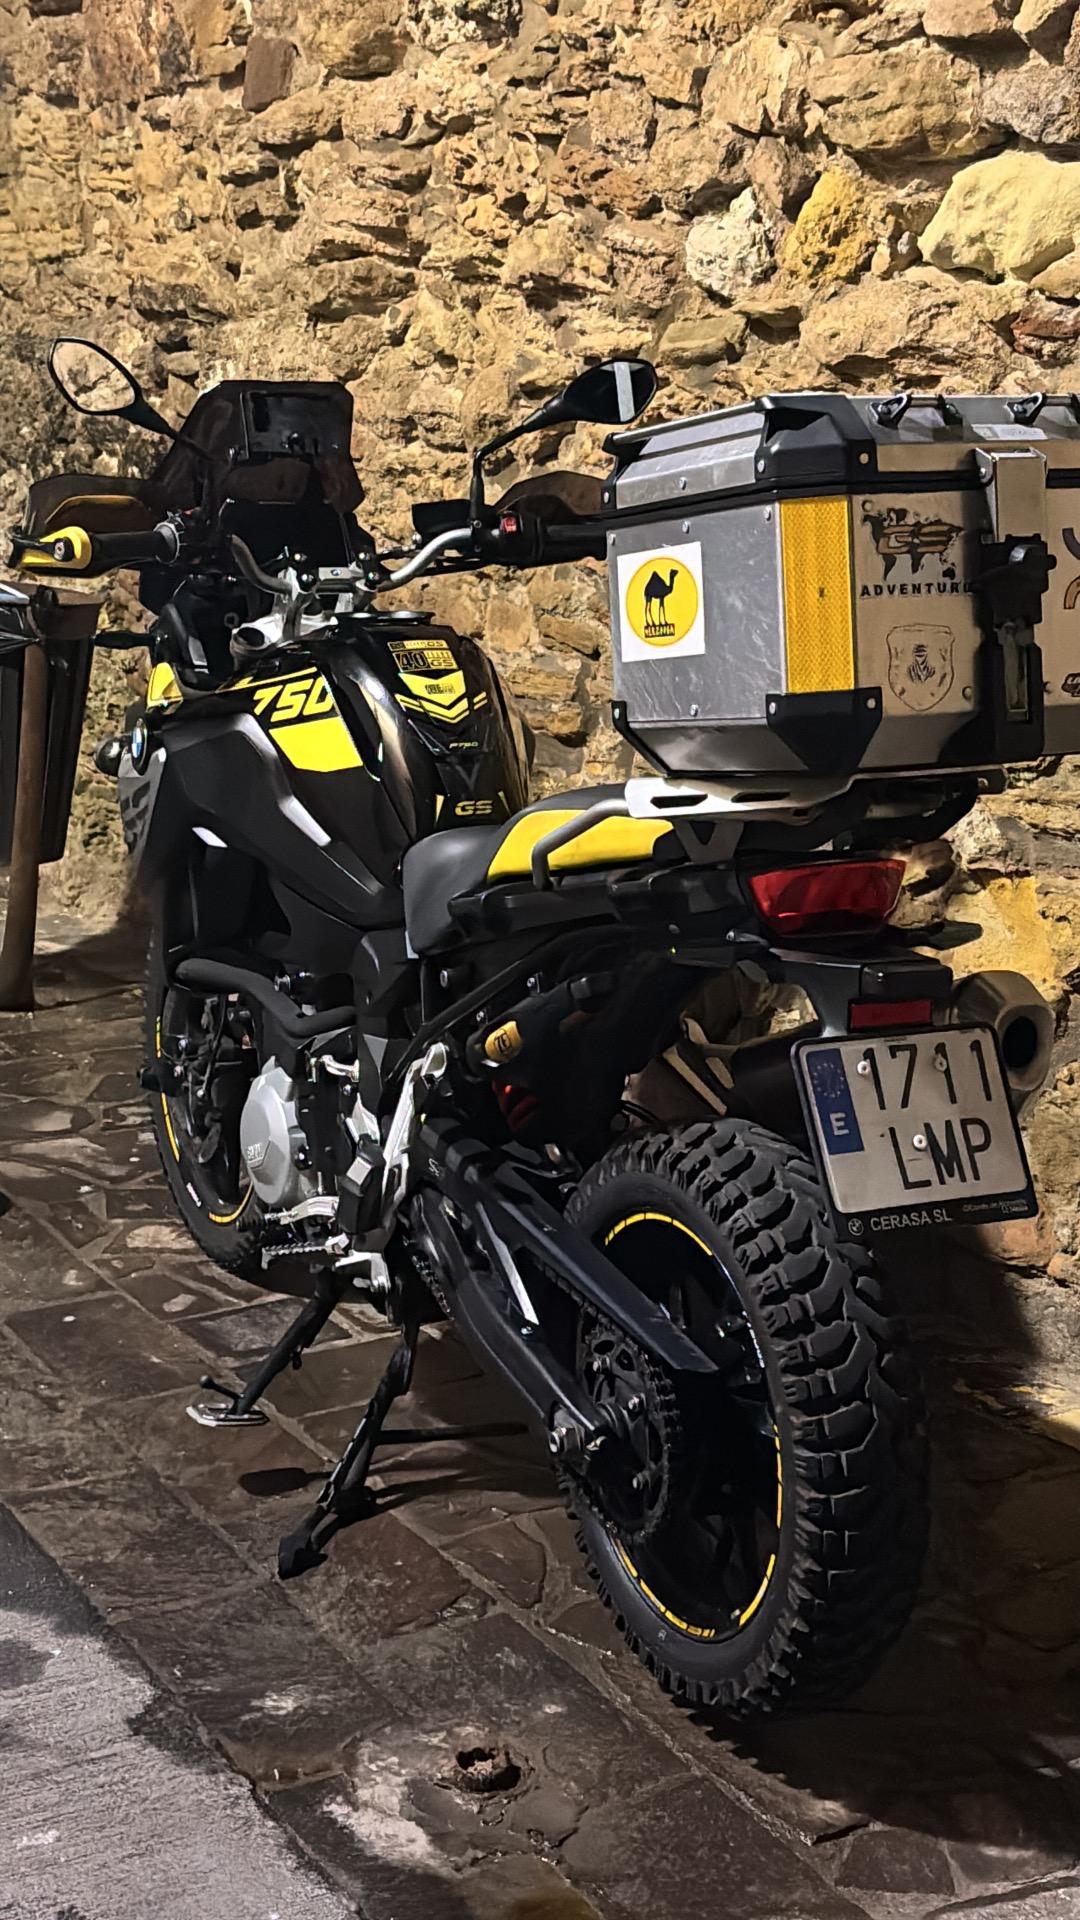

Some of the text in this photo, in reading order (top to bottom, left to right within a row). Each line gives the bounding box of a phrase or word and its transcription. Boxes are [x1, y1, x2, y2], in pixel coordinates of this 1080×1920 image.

[400, 653, 427, 669] 40
[431, 659, 454, 667] GS
[252, 675, 335, 722] 750
[455, 800, 493, 816] GS
[862, 1039, 993, 1110] 1711
[829, 1112, 850, 1136] E
[888, 1118, 993, 1190] LMP
[870, 1209, 953, 1232] CERASA SL
